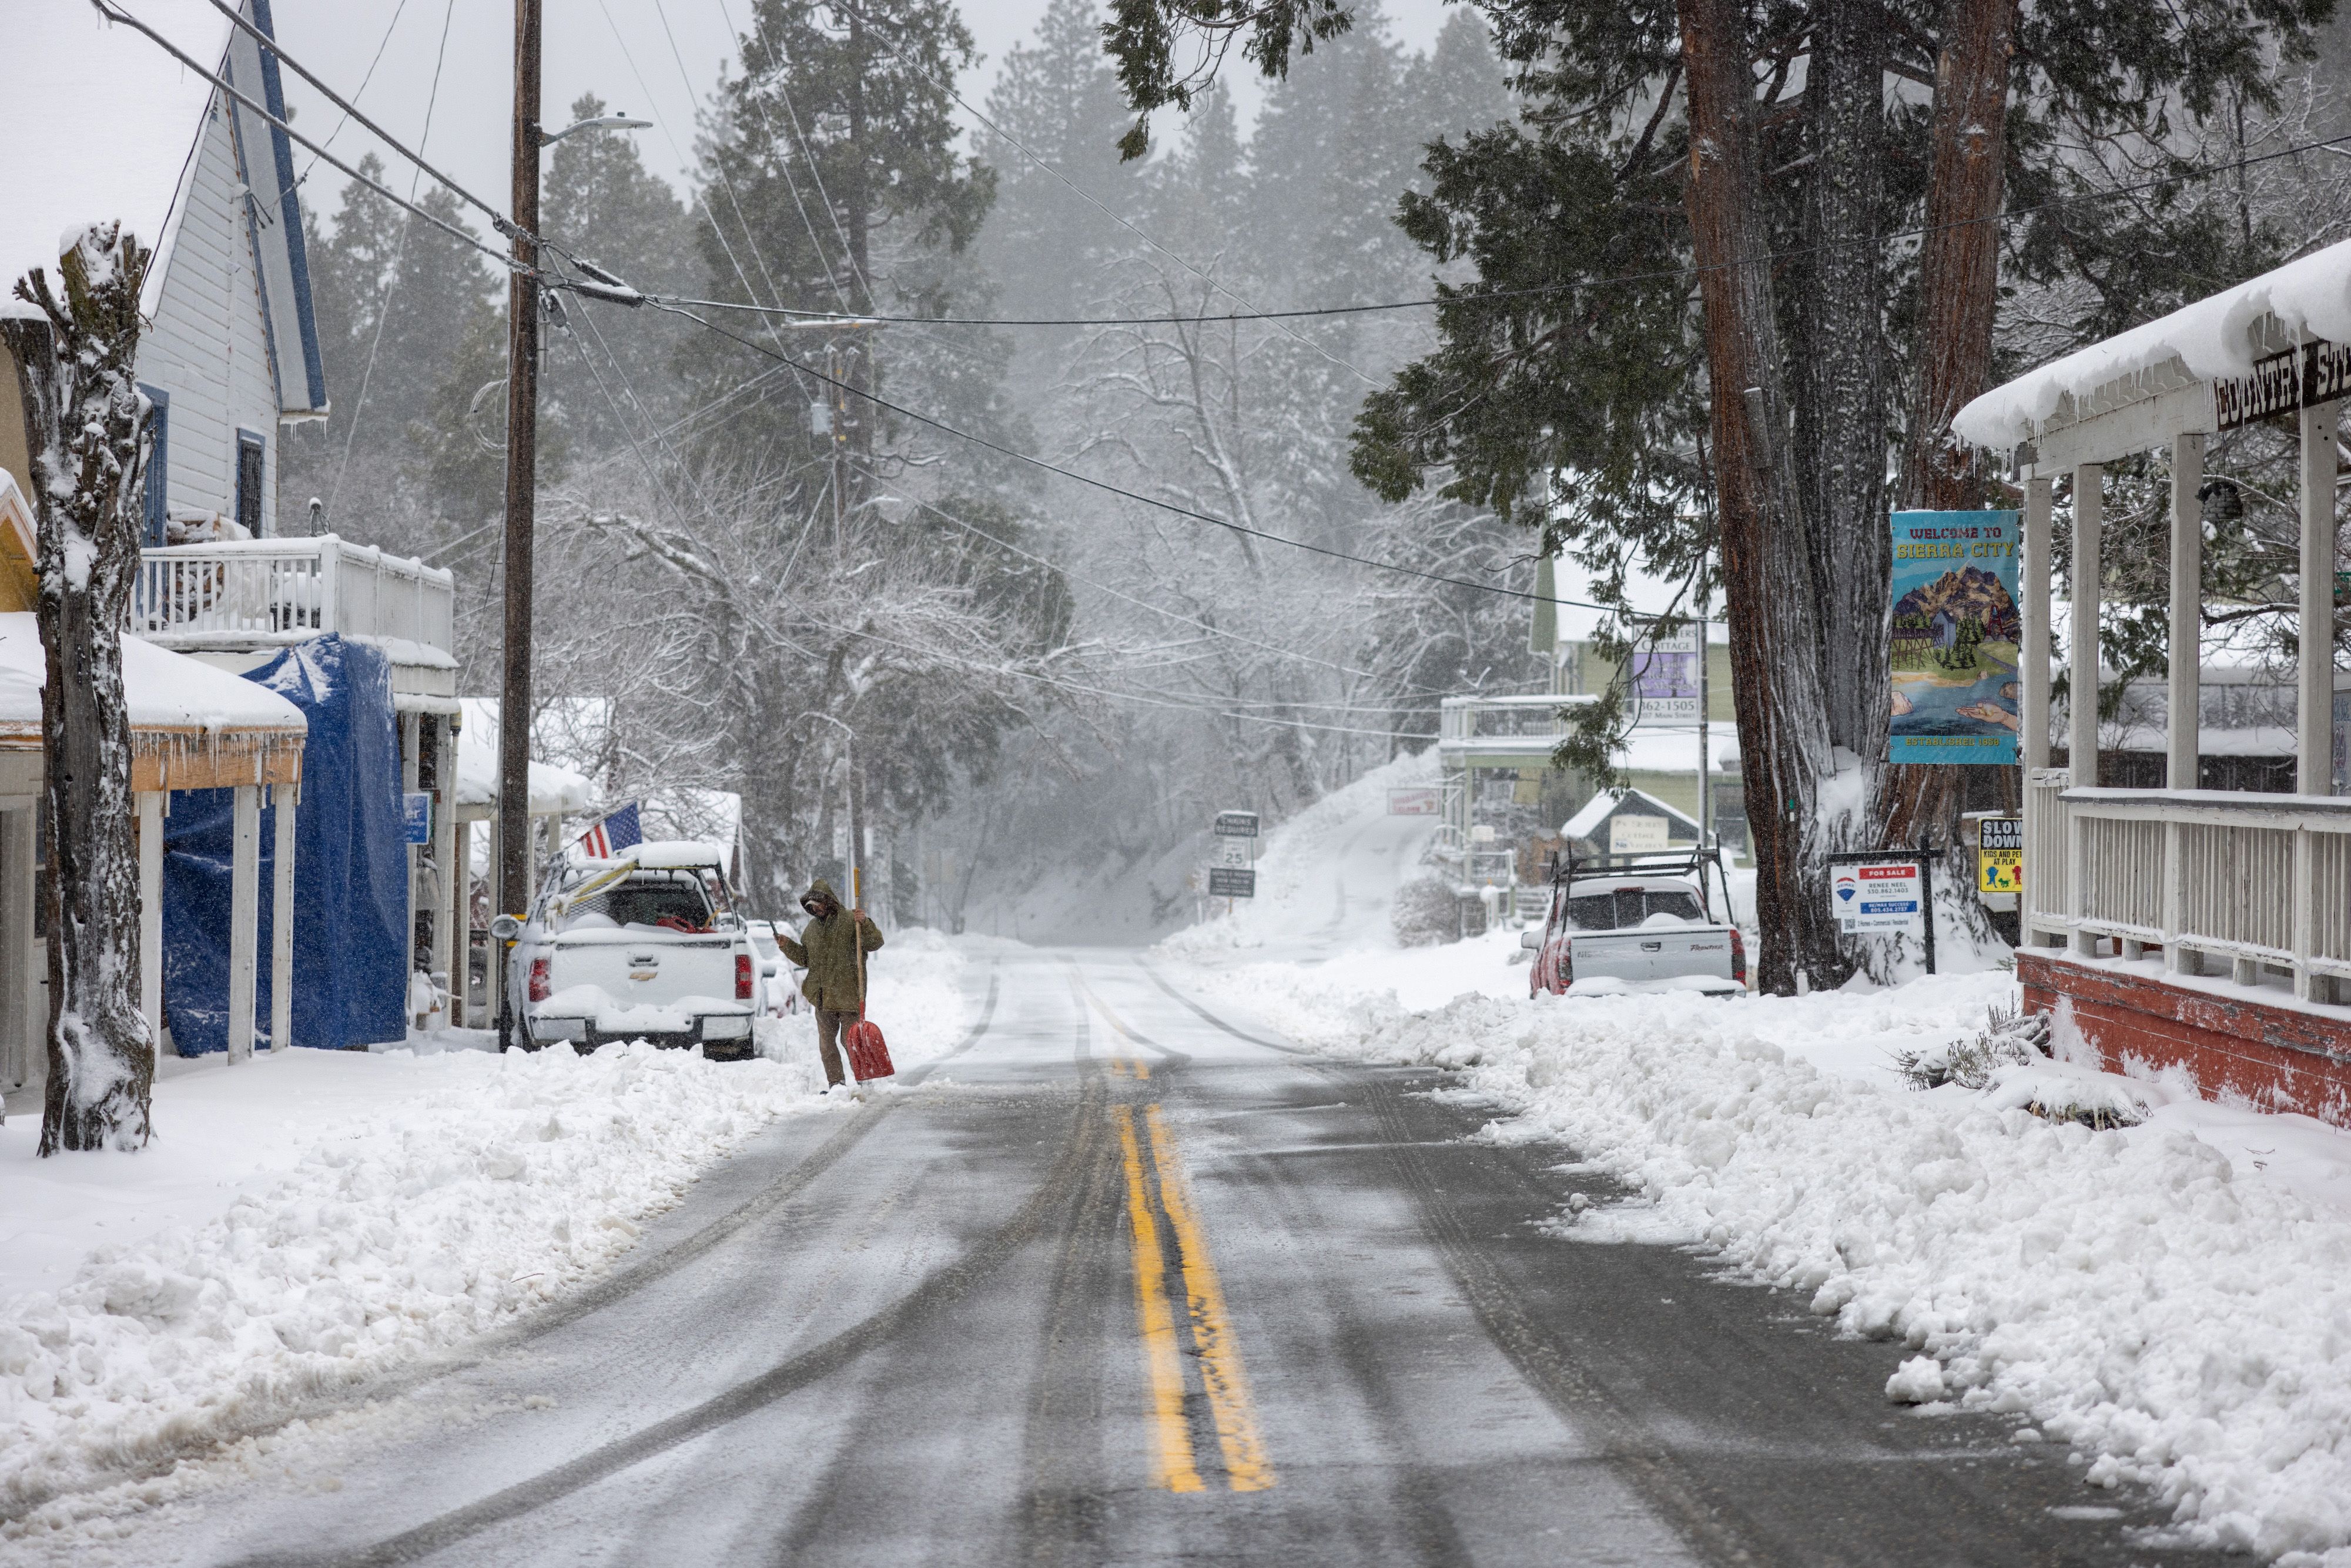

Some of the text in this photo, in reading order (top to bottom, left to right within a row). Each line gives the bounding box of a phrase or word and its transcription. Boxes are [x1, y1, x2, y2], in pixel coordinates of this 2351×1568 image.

[1910, 527, 2001, 540] WELCOME TO
[1897, 542, 2015, 559] SIERRA CITY
[1905, 738, 2000, 746] ESTABLISHED 1850
[1225, 853, 1243, 865] 25
